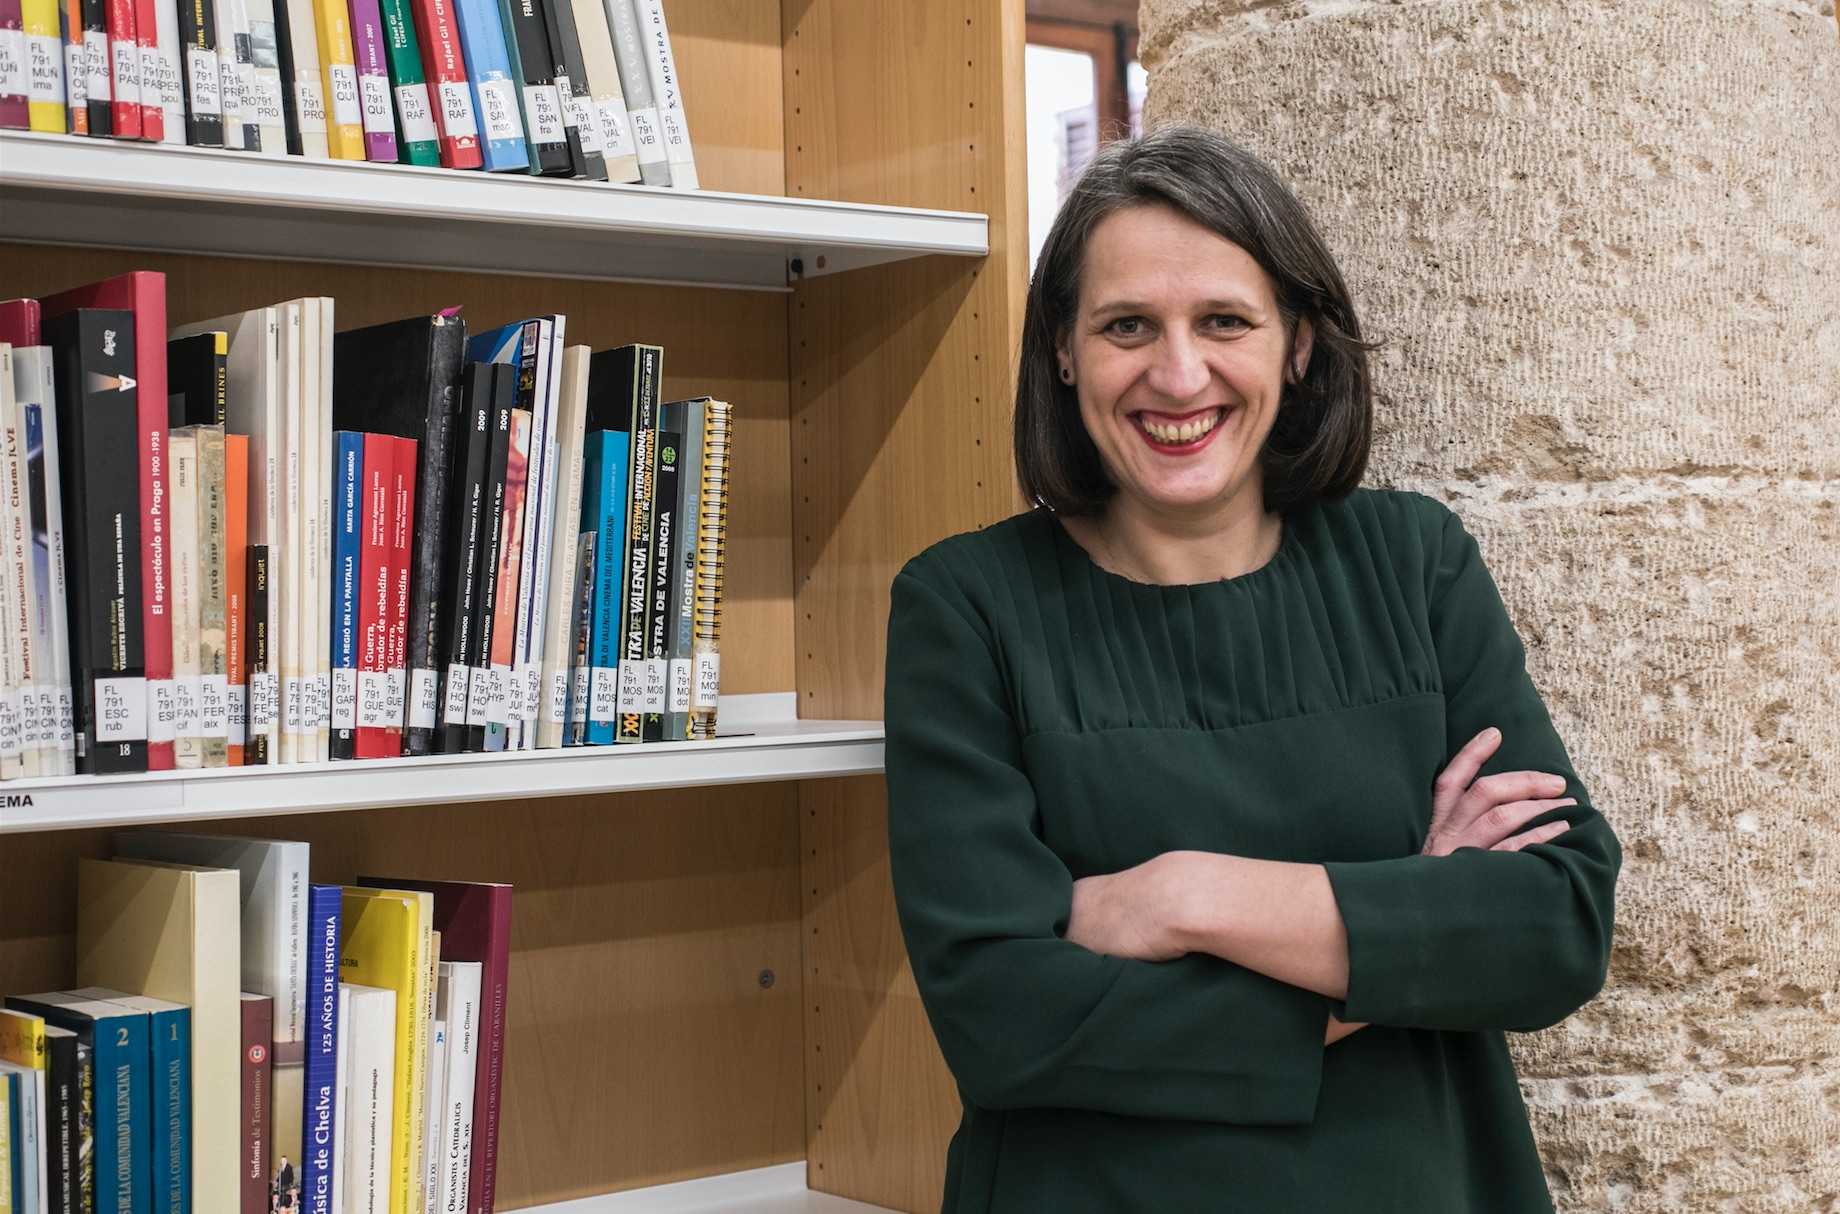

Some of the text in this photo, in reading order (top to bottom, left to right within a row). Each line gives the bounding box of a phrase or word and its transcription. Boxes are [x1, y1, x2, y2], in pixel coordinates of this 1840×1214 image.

[392, 26, 401, 48] Rafael
[31, 42, 45, 52] FL
[439, 26, 454, 69] Rafael Gil
[32, 55, 50, 64] 791
[656, 31, 672, 84] MOSTRA
[195, 59, 207, 69] FL
[32, 66, 58, 78] MUÑ
[196, 71, 212, 80] 791
[334, 69, 347, 78] FL
[197, 83, 217, 93] PRE
[336, 80, 352, 89] 791
[302, 87, 313, 98] FL
[336, 92, 355, 101] QUI
[402, 89, 413, 98] FL
[535, 93, 546, 102] FL
[303, 100, 319, 108] 791
[404, 100, 418, 109] 791
[304, 110, 325, 119] PRO
[407, 110, 425, 119] RAF
[538, 115, 557, 124] SAN
[640, 136, 655, 144] VEI
[500, 409, 508, 431] 2009
[644, 428, 655, 467] AVENTURA
[635, 429, 647, 500] INTERNACIONAL
[151, 481, 162, 514] Praga
[642, 501, 650, 510] DE
[632, 499, 642, 540] FESTIVAL
[152, 518, 161, 532] en
[642, 533, 649, 541] DE
[657, 512, 670, 586] VALENCIA
[9, 460, 31, 680] Festival Internacional de Cine Cinema
[150, 535, 165, 602] espectáculo
[377, 566, 387, 632] de rebeldías
[396, 568, 407, 633] de rebeldías
[461, 616, 469, 653] HOLLYWOOD
[466, 549, 474, 574] Christian
[627, 548, 646, 660] TRA DE VALENCIA
[655, 590, 665, 611] DE
[152, 605, 163, 614] El
[344, 602, 351, 612] LA
[116, 597, 125, 632] ESCRIVÁ
[344, 615, 351, 626] EN
[482, 615, 491, 652] HOLLYWOOD
[342, 628, 351, 654] REGIÓ
[364, 623, 375, 663] Guerra,
[387, 624, 396, 664] Guerra,
[117, 633, 126, 670] VICENTE
[344, 656, 350, 667] LA
[702, 661, 712, 670] FL
[624, 666, 633, 675] FL
[702, 671, 716, 679] 791
[336, 673, 347, 682] FL
[598, 672, 608, 681] FL
[624, 676, 636, 684] 791
[203, 684, 215, 693] FL
[336, 684, 350, 693] 791
[366, 679, 376, 688] FL
[598, 683, 611, 691] 791
[104, 685, 118, 695] FL
[365, 690, 380, 699] 791
[623, 686, 642, 695] MOS
[40, 694, 52, 703] FL
[105, 697, 123, 706] 791
[204, 695, 220, 704] 791
[336, 695, 355, 704] GAR
[597, 694, 617, 702] MOS
[622, 698, 633, 706] cat
[364, 700, 384, 710] GUE
[41, 706, 55, 715] 791
[105, 708, 128, 719] ESC
[204, 707, 225, 716] FER
[336, 709, 349, 718] reg
[41, 718, 56, 728] CIN
[364, 713, 378, 723] agr
[106, 721, 122, 731] rub
[204, 719, 218, 728] aix
[120, 744, 131, 756] 18
[321, 916, 336, 1054] 125 AÑOS DE HISTORIA
[170, 1023, 178, 1040] 1
[463, 1002, 472, 1055] Josep Climent
[116, 1028, 129, 1047] 2
[253, 1070, 261, 1125] Testimonios
[315, 1086, 331, 1144] Chelva
[168, 1059, 181, 1202] DE LA COMUNIDAD VALENCIANA
[253, 1128, 261, 1138] de
[115, 1065, 131, 1209] DE LA COMUNIDAD VALENCIANA
[462, 1141, 469, 1150] S.
[314, 1149, 328, 1170] de
[448, 1102, 462, 1212] ORGANISTES CATEDRALICIS
